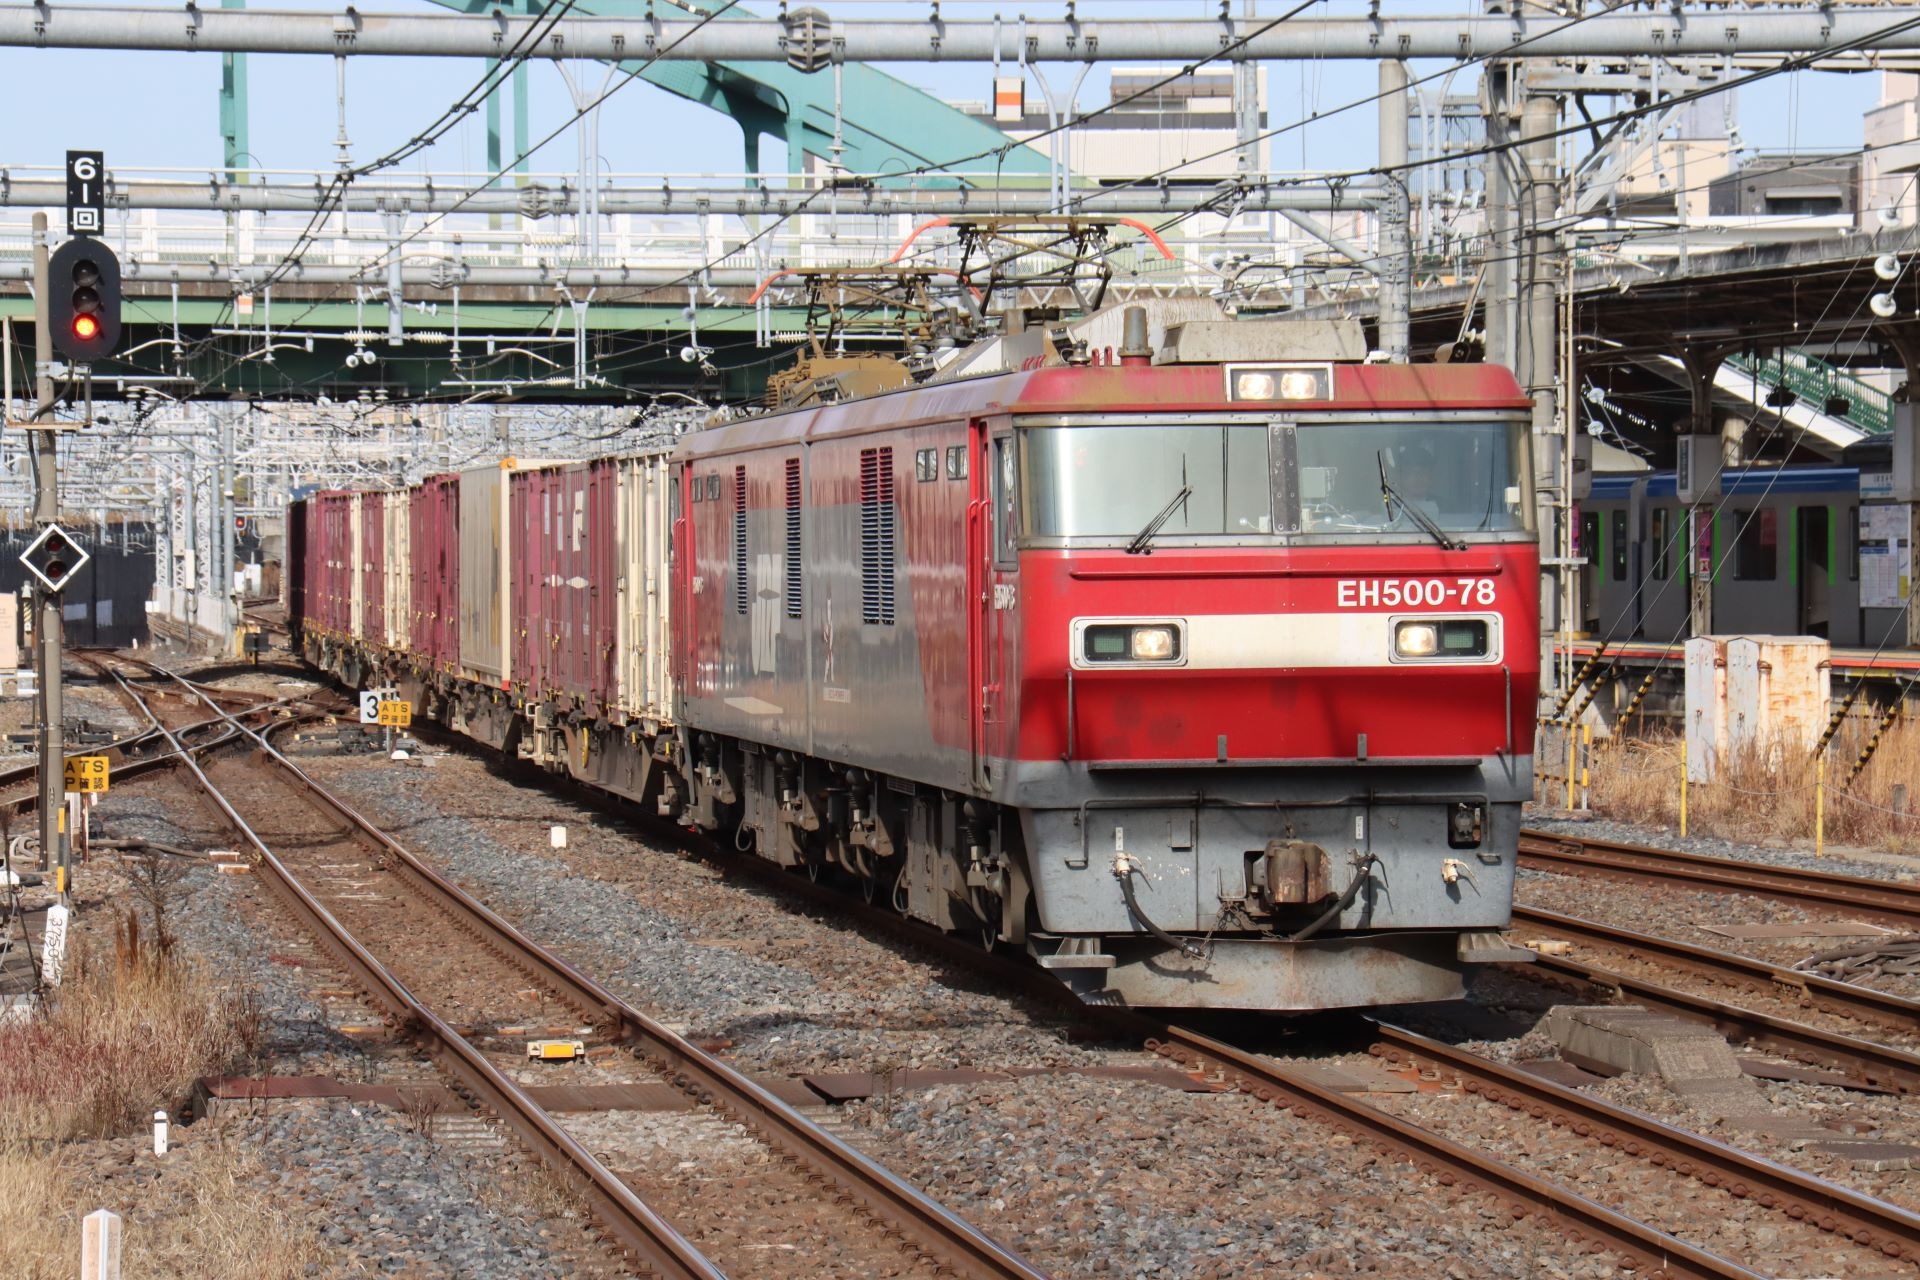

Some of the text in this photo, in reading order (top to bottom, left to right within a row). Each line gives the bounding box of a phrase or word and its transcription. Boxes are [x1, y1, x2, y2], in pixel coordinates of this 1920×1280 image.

[1337, 578, 1496, 607] EH500-78
[382, 703, 408, 713] ATS
[65, 760, 104, 773] ATS
